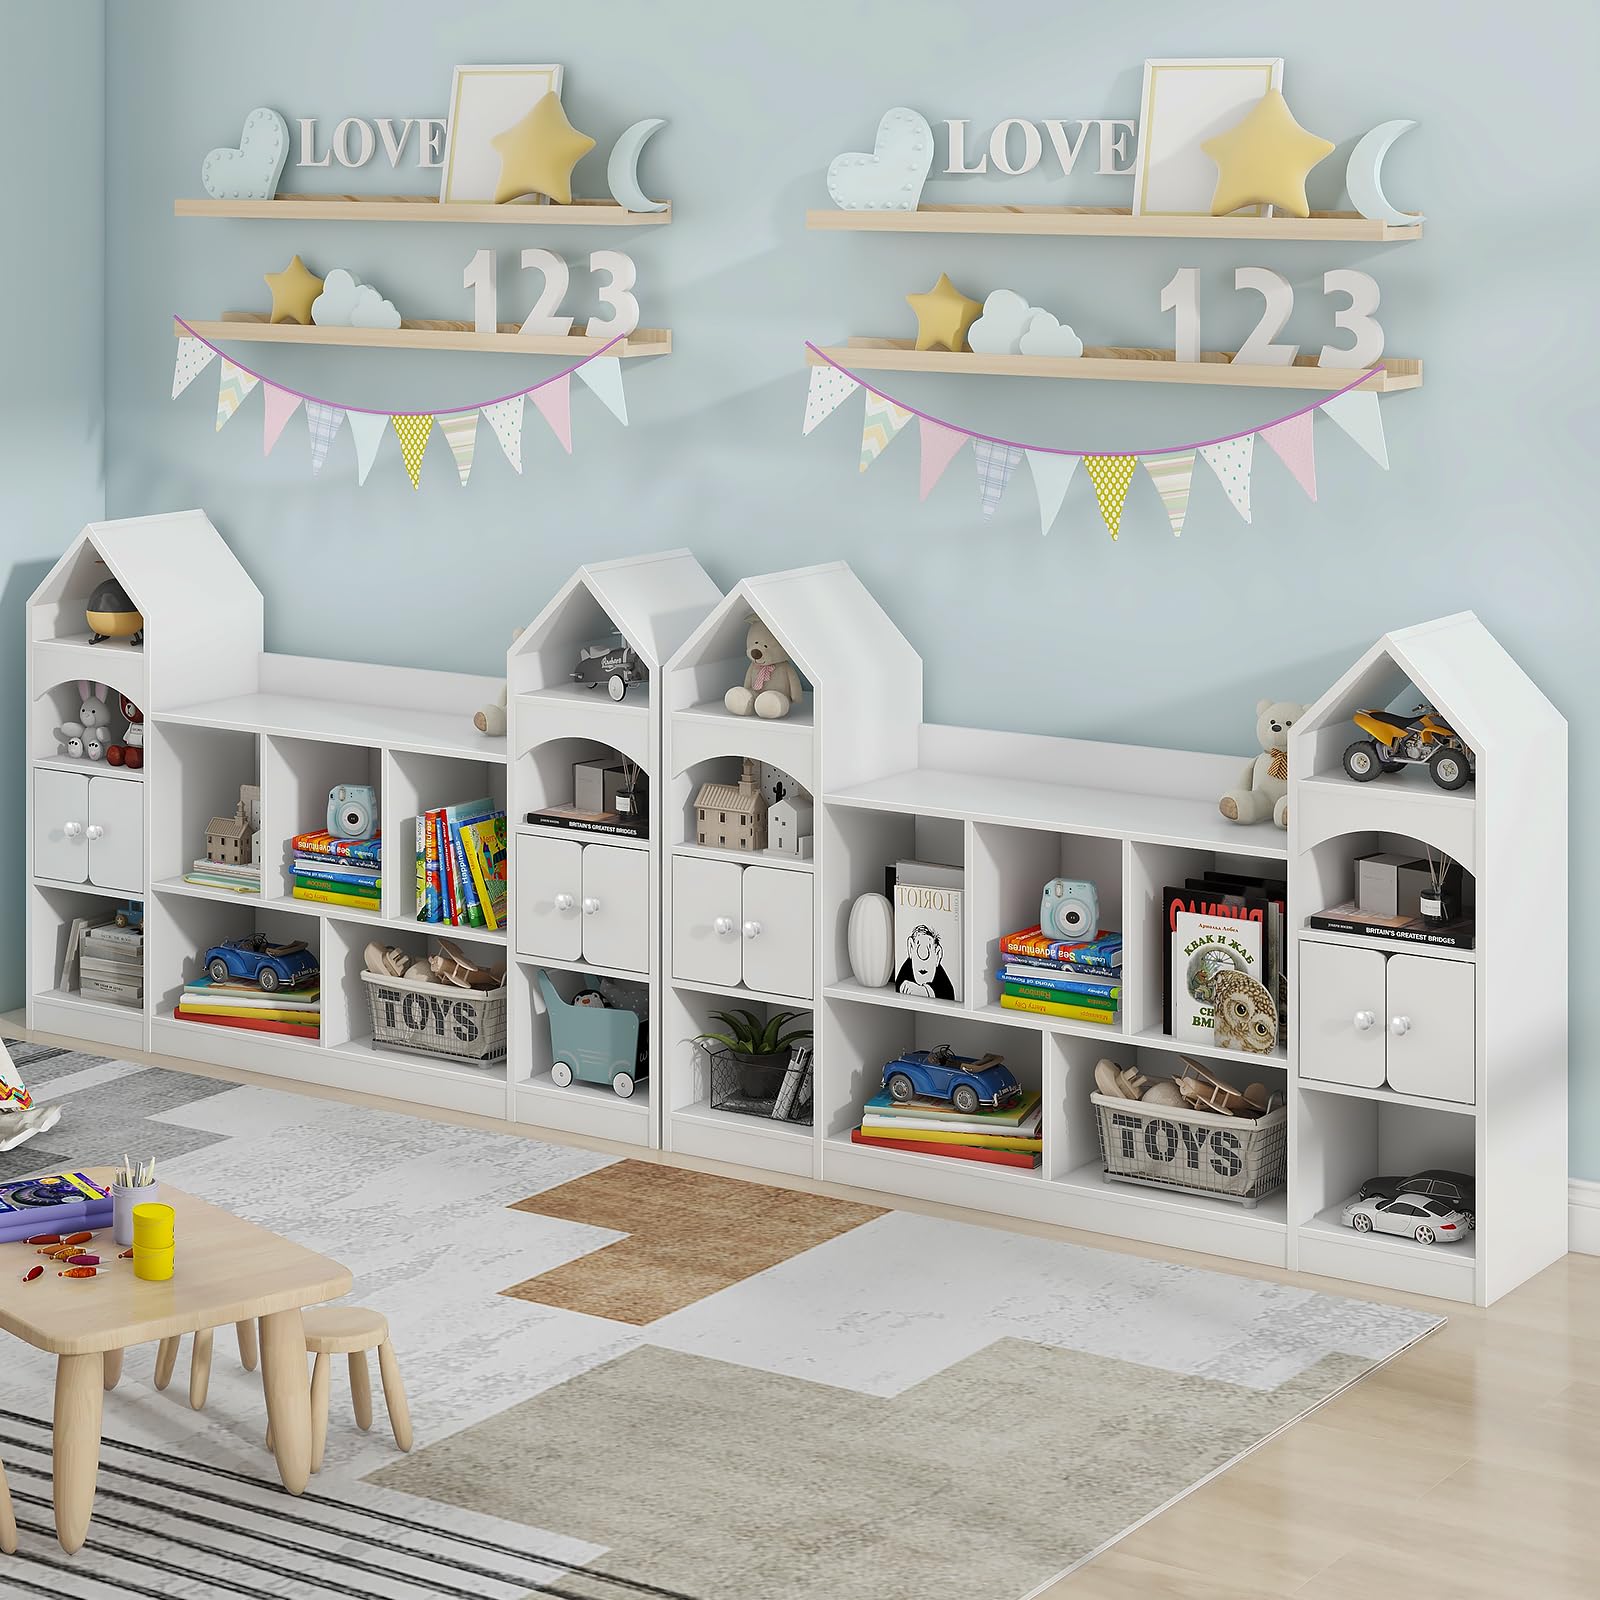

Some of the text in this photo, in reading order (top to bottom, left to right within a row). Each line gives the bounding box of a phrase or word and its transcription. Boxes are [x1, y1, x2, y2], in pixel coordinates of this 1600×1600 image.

[296, 118, 447, 168] LOVE
[943, 119, 1135, 175] LOVE
[568, 821, 591, 830] BRITAIN'S
[592, 824, 616, 833] GREATEST
[616, 827, 638, 835] BRIDGES
[298, 841, 351, 856] Sea adventures
[1366, 927, 1456, 945] BRITAIN'S GREATEST BRIDGES
[1008, 943, 1076, 961] Sea adventures
[1184, 934, 1214, 956] КВАК
[1228, 939, 1254, 964] ЖАБ
[1035, 980, 1055, 988] World
[1087, 988, 1109, 996] Sydney
[378, 988, 479, 1042] TOYS
[1112, 1113, 1243, 1177] TOYS
